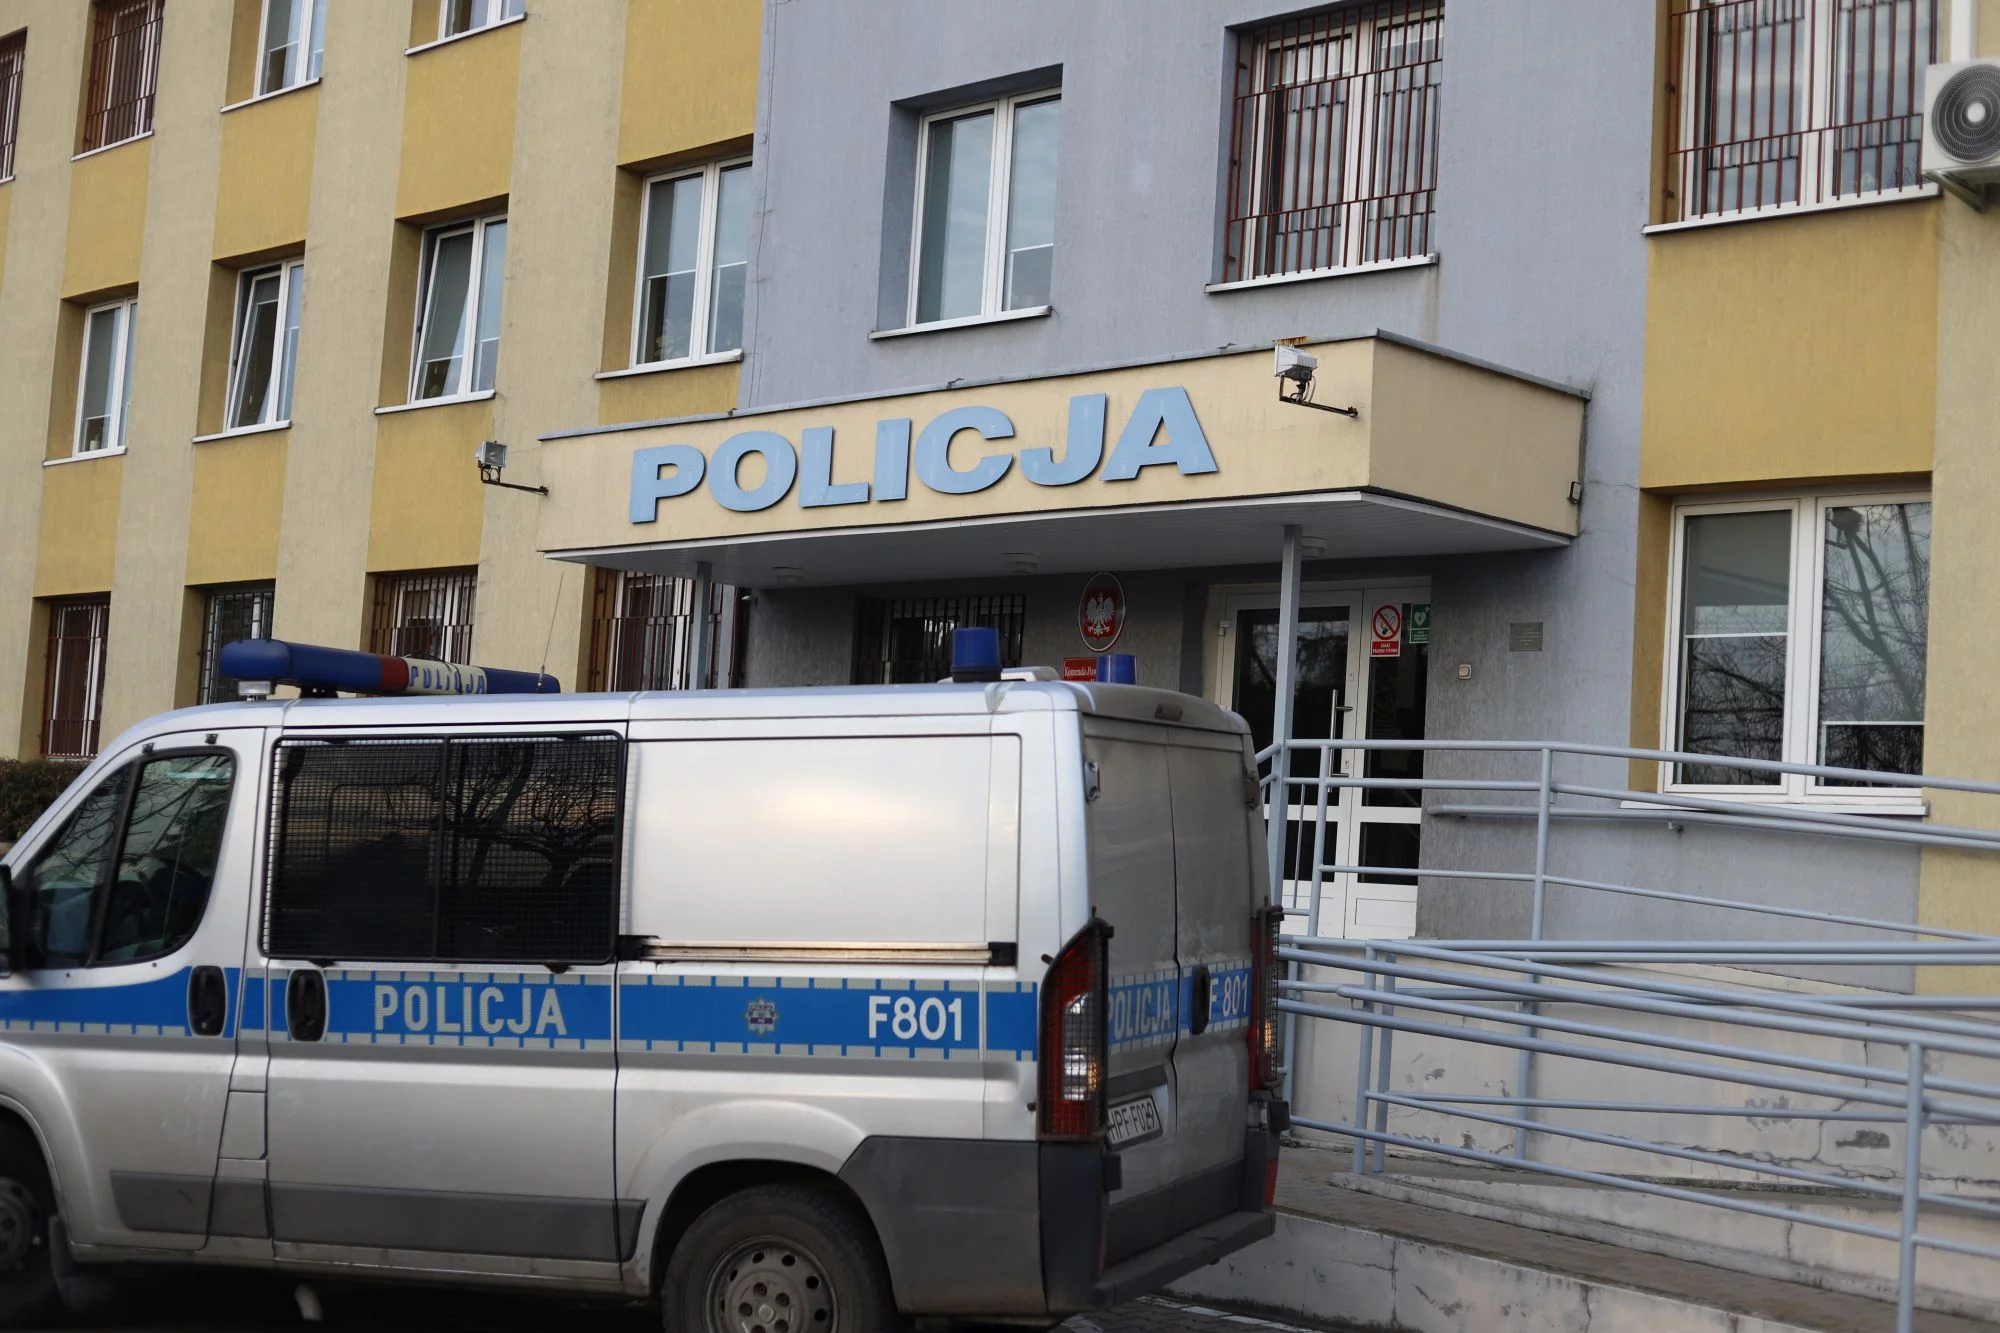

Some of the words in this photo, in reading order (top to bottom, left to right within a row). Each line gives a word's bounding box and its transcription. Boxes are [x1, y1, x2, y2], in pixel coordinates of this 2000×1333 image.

[629, 385, 1218, 524] POLICJA
[374, 984, 568, 1035] POLICJA
[868, 995, 962, 1041] F801
[1208, 978, 1219, 1021] F
[1222, 973, 1249, 1018] 801
